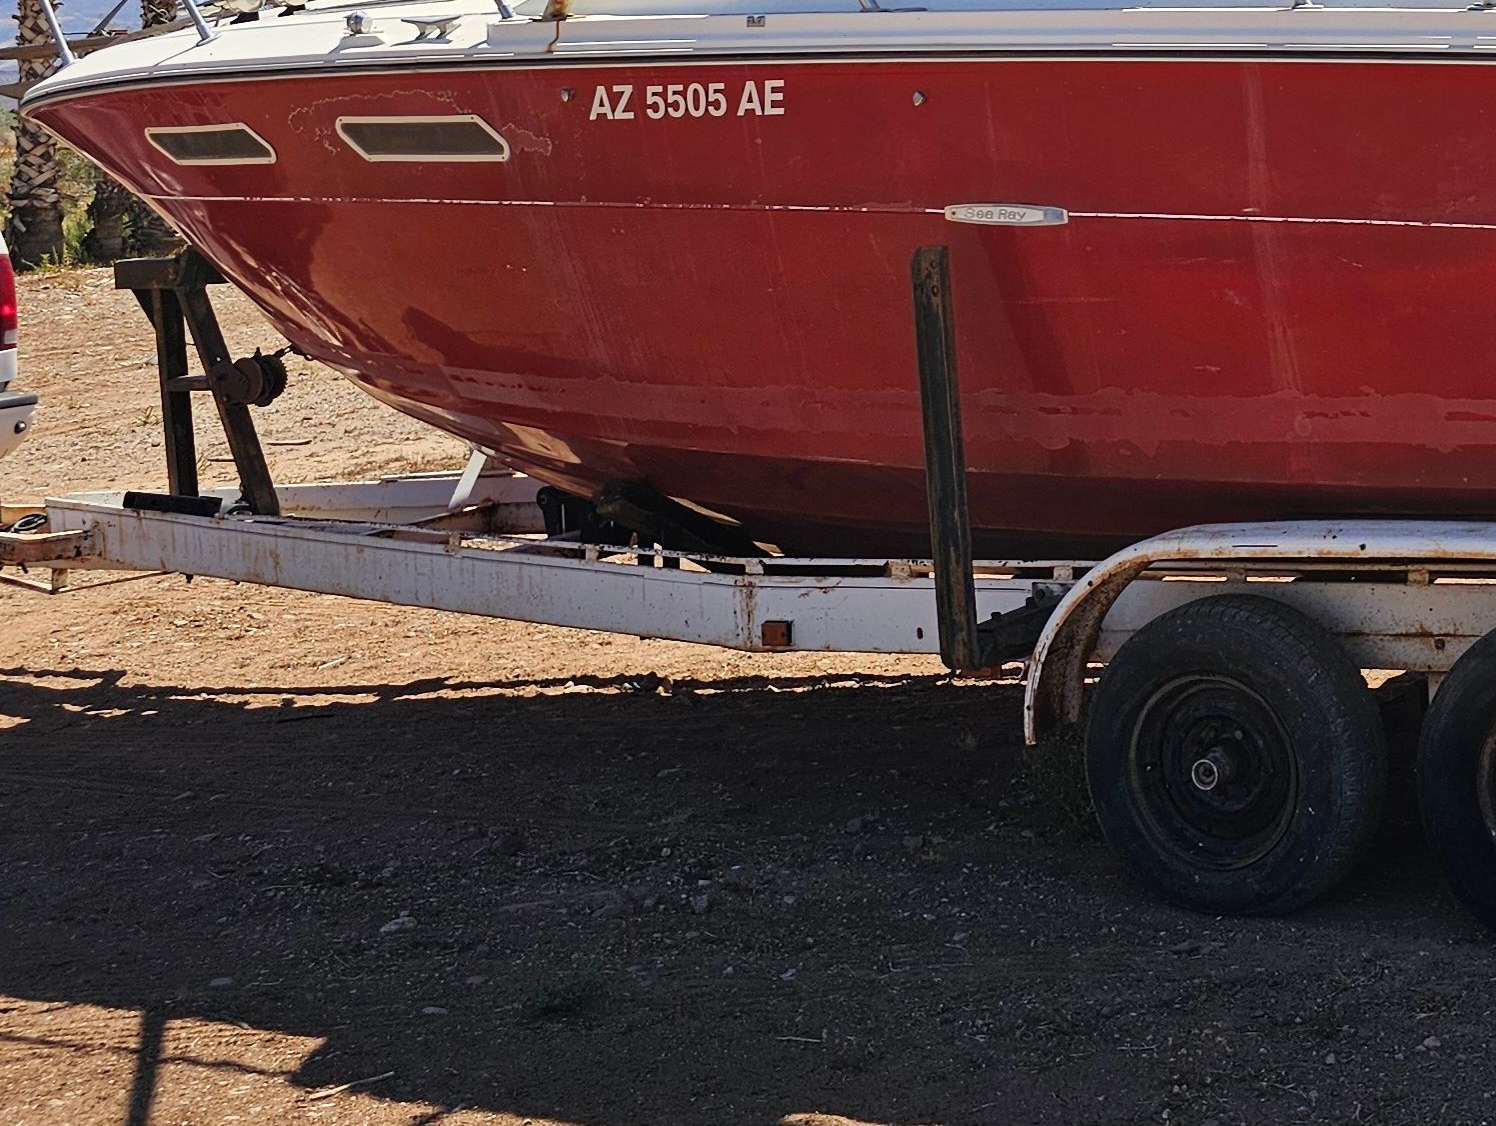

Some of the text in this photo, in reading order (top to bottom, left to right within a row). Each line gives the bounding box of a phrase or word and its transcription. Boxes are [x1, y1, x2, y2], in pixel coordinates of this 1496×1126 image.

[589, 79, 786, 121] AZ 5505 AE
[964, 206, 1027, 221] Sea Ray
